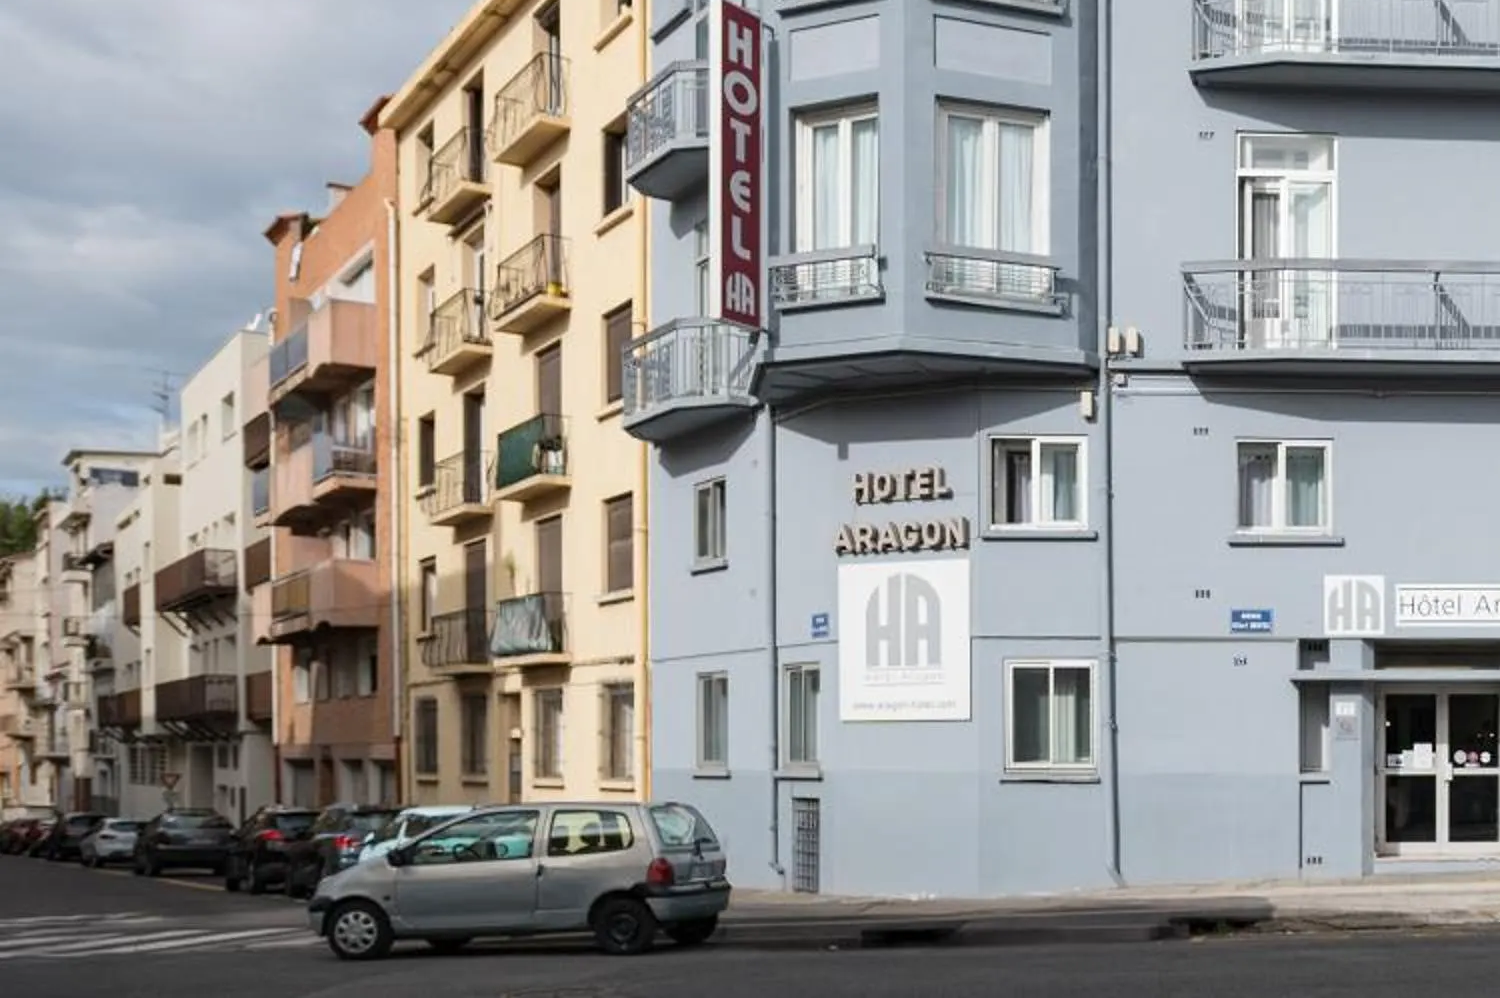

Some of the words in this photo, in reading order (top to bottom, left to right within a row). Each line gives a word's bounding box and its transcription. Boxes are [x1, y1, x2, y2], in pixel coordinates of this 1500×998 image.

[723, 19, 757, 261] HOTEL
[853, 466, 953, 504] HOTEL
[833, 518, 970, 556] ARAGON
[866, 573, 941, 666] HA
[1328, 580, 1381, 631] HA
[1399, 593, 1462, 617] Hôtel
